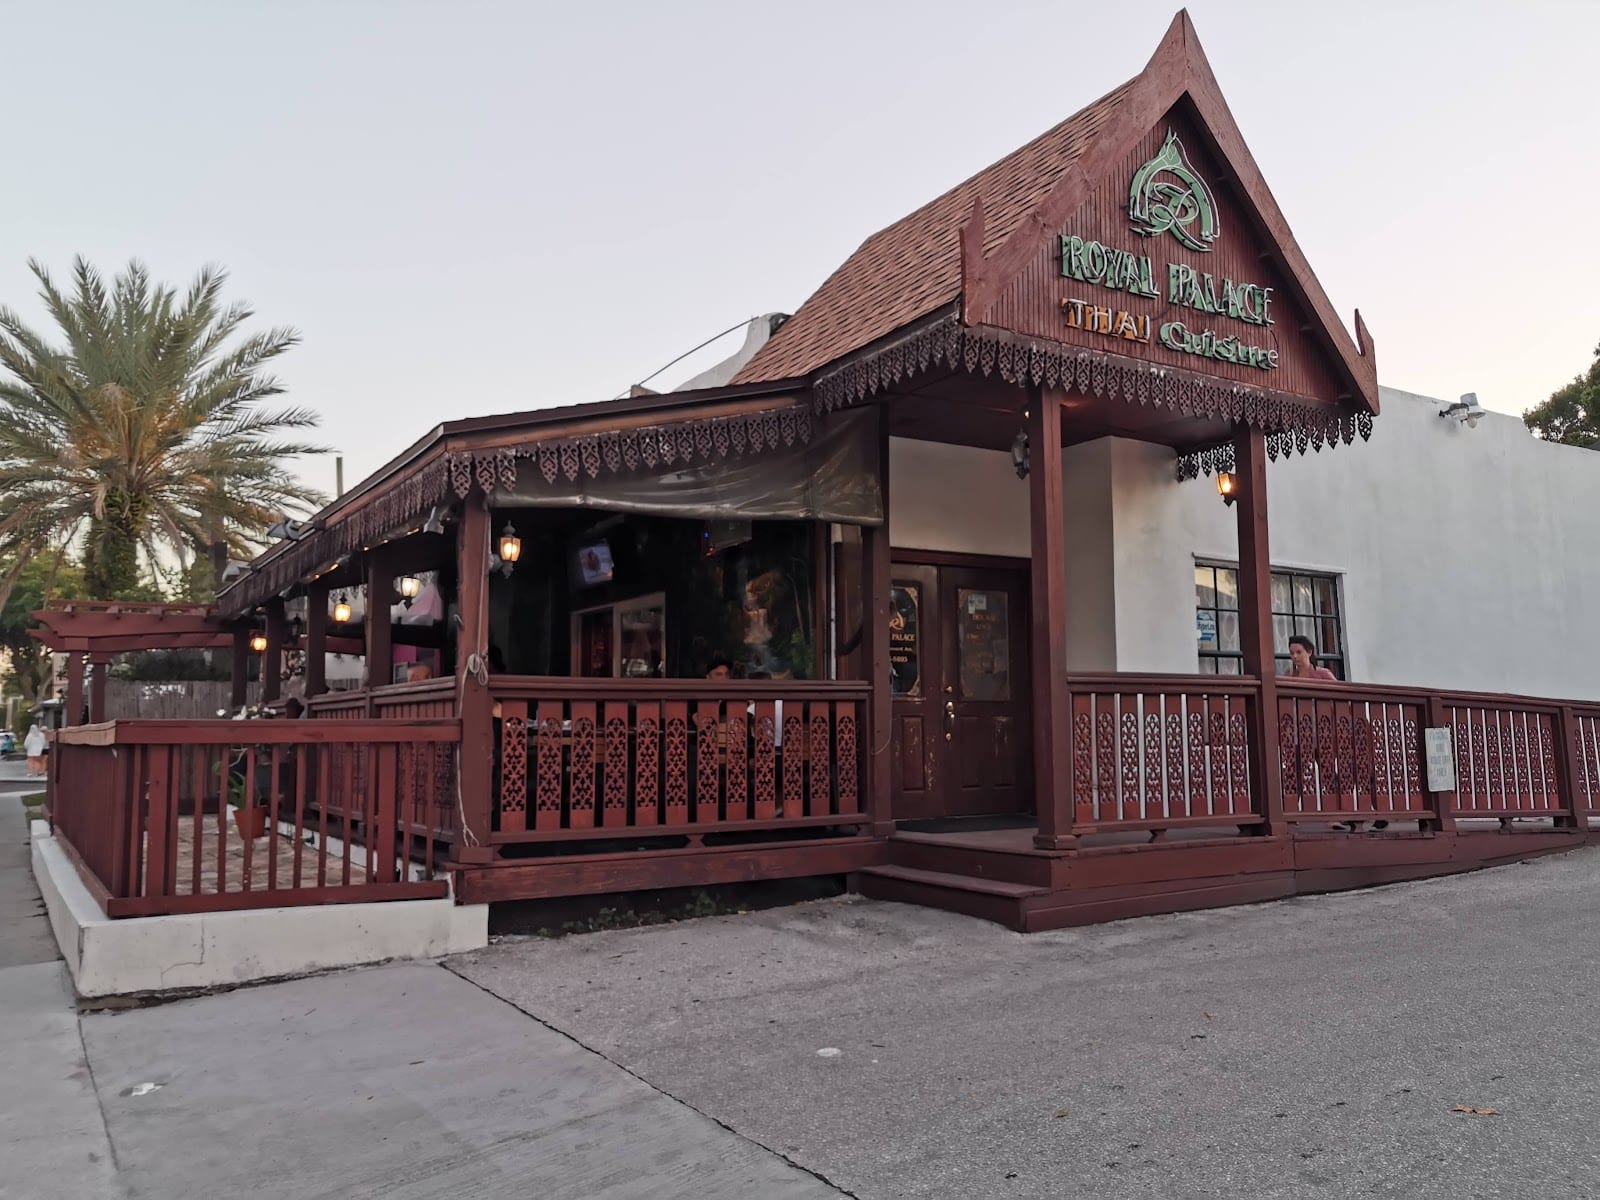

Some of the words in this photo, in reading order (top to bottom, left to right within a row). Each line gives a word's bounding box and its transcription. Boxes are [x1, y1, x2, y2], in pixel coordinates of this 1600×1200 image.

[1058, 234, 1160, 298] ROYAL
[1168, 263, 1275, 327] PALACE
[1061, 298, 1150, 343] THAI
[1158, 321, 1279, 370] Cuisine
[891, 633, 916, 641] PALACE
